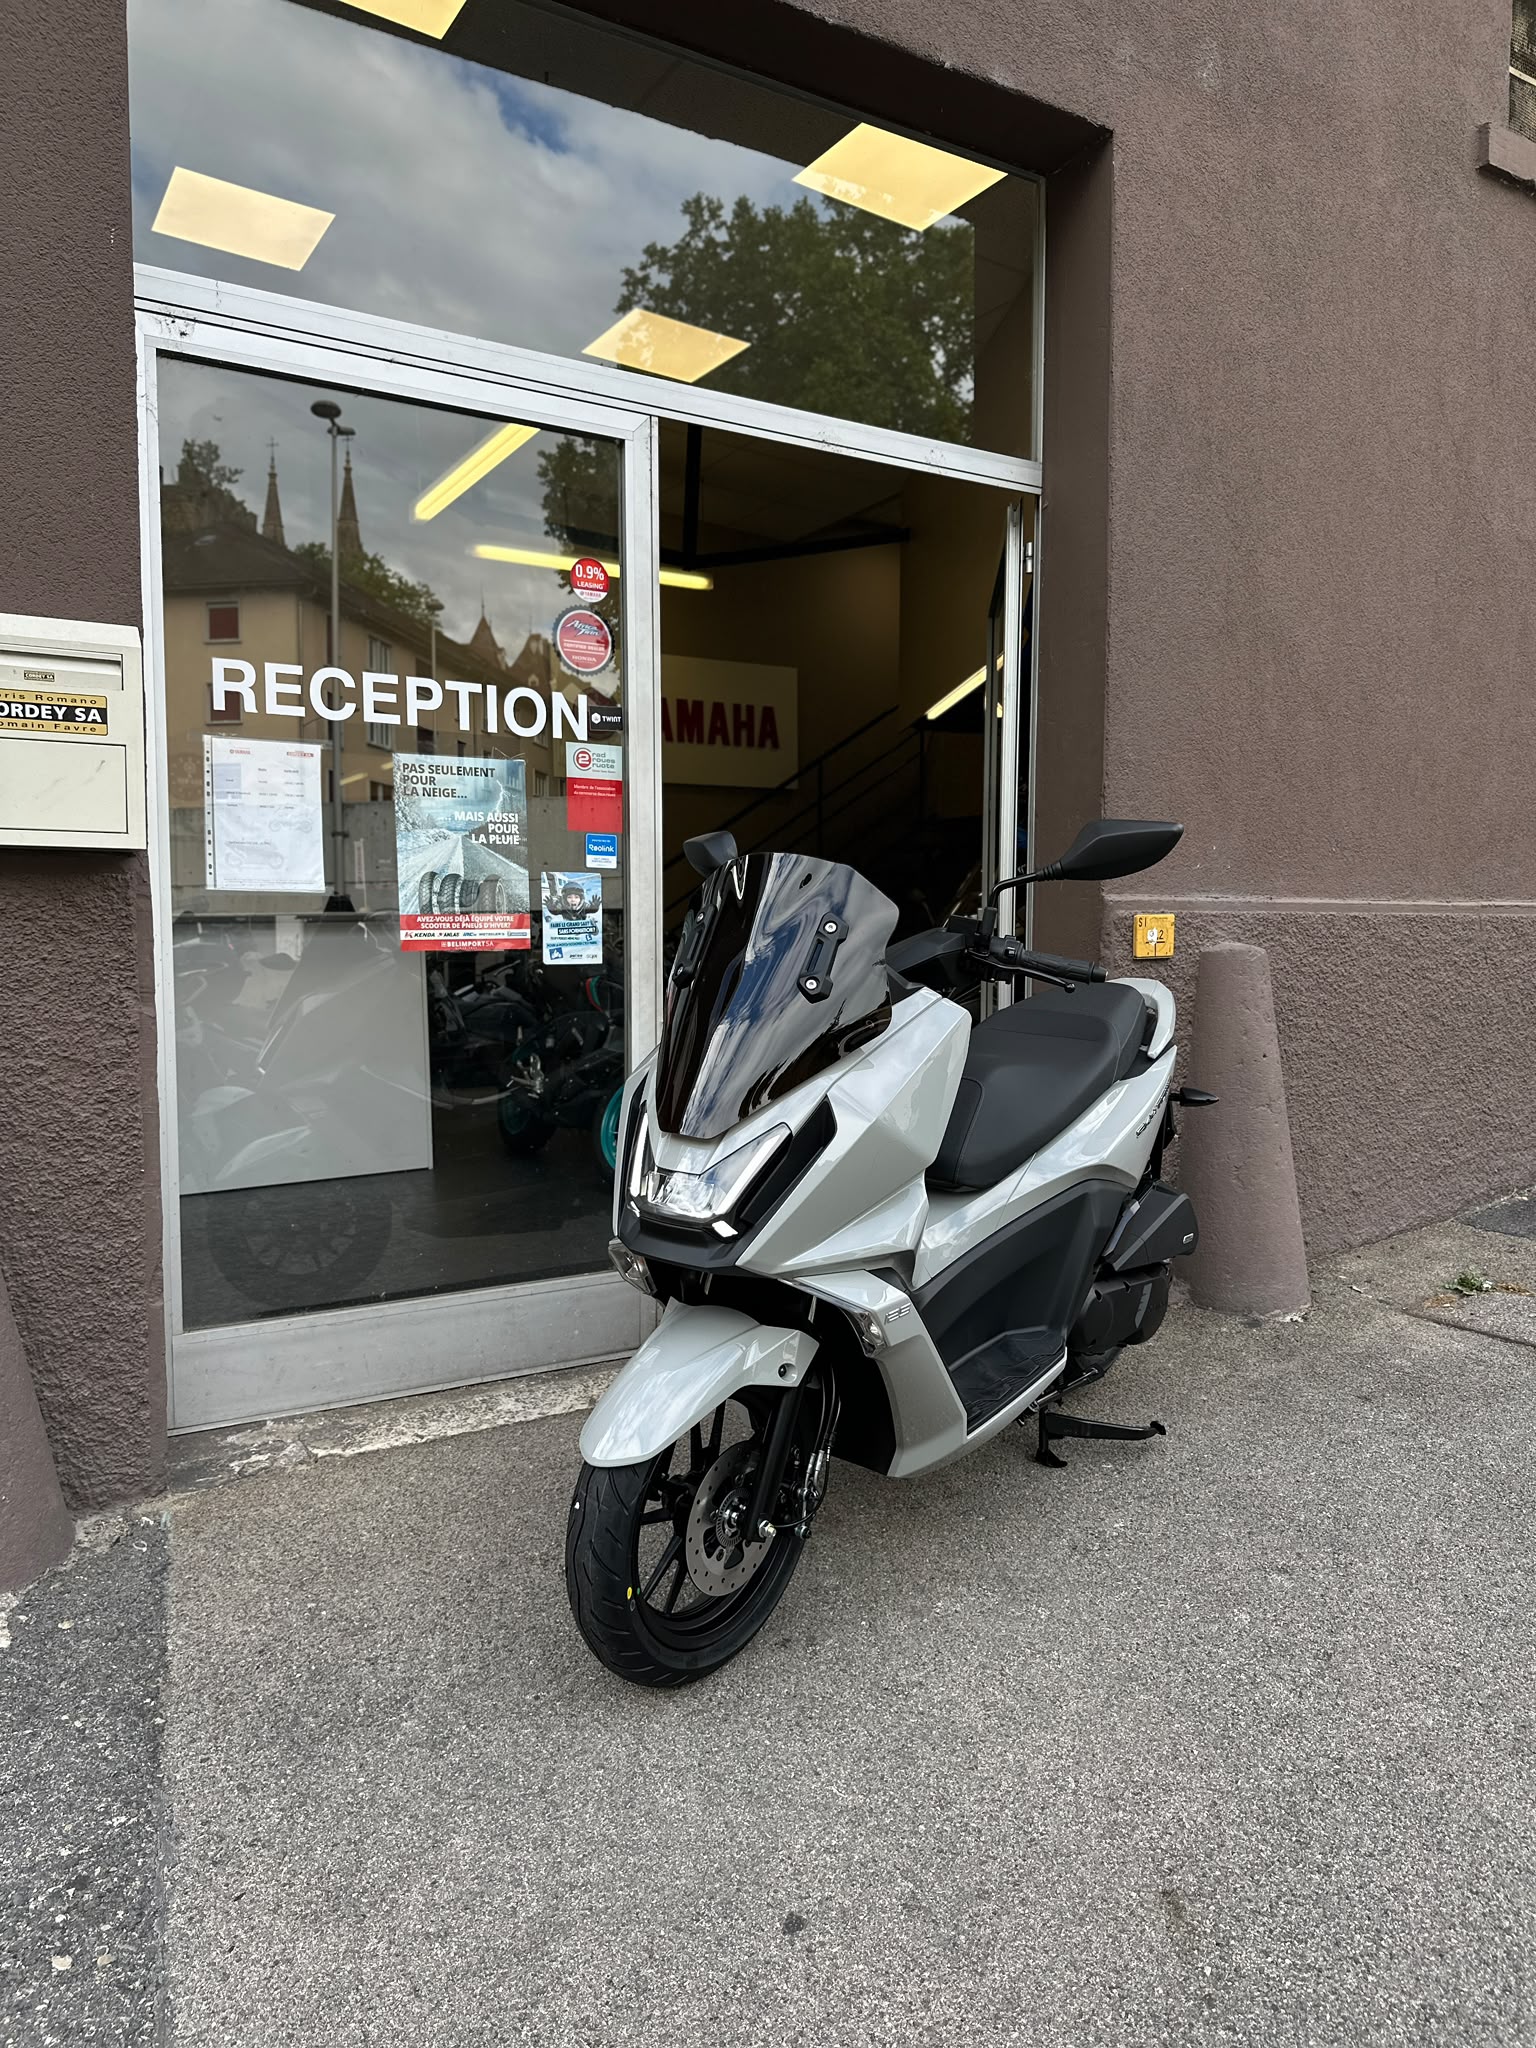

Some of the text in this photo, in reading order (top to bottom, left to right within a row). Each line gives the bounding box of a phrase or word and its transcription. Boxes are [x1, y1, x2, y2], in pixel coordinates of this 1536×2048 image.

[575, 564, 605, 581] 0.9%
[0, 692, 97, 705] ris Romano
[212, 657, 588, 741] RECEPTION
[74, 707, 103, 723] SA
[602, 715, 621, 723] TWINT
[54, 723, 97, 733] Favre
[402, 763, 496, 778] PAS SEULEMENT
[403, 775, 436, 786] POUR
[404, 786, 467, 799] LA NEIGE...
[454, 811, 485, 822] MAIS
[487, 812, 519, 823] AUSSI
[488, 823, 520, 834] POUR
[471, 833, 520, 845] LA PLUIE
[589, 844, 615, 852] Reolink
[471, 914, 494, 923] ÉQUIPÉ
